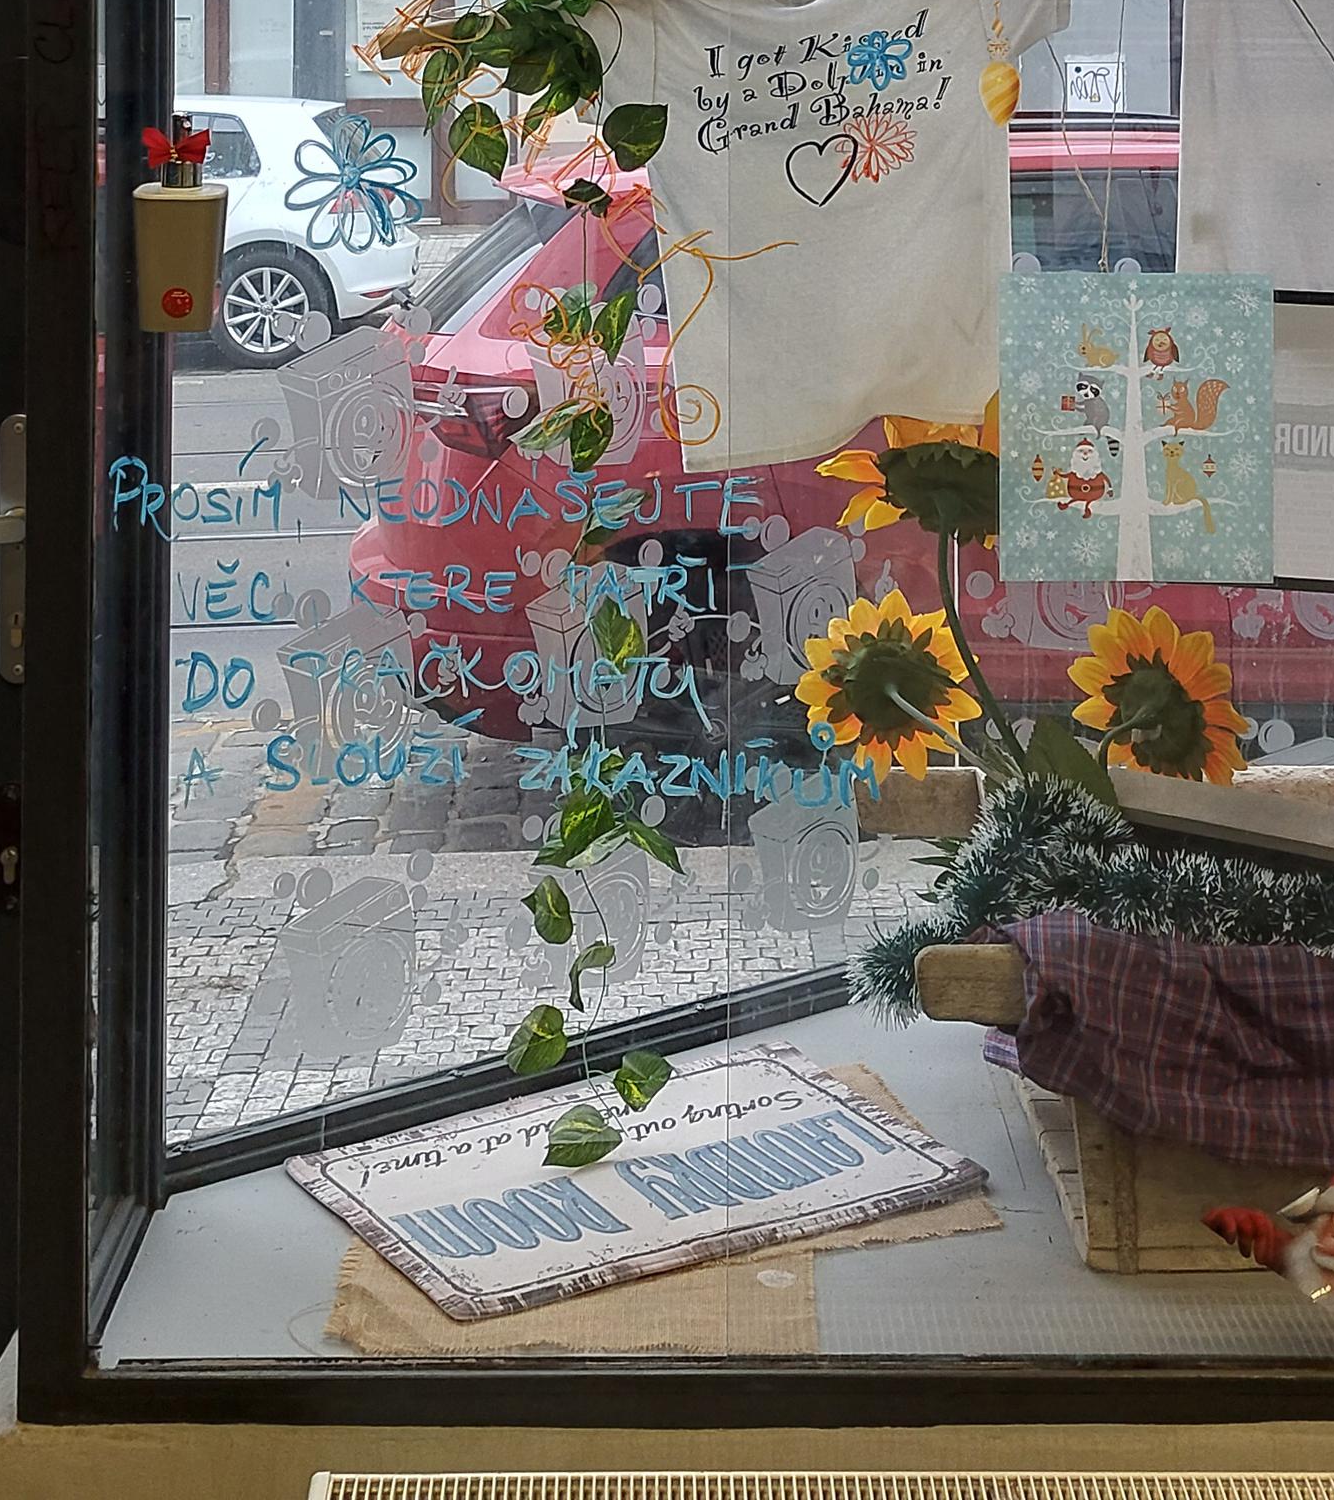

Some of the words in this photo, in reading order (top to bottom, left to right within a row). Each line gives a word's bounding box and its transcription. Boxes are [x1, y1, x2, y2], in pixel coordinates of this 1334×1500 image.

[693, 85, 730, 121] by
[743, 86, 758, 103] a
[915, 50, 945, 76] in
[704, 44, 726, 79] I
[736, 45, 787, 82] got
[697, 102, 800, 156] Grand
[809, 76, 954, 129] Bahama!
[337, 467, 765, 536] NEODNAŠEJTE
[176, 650, 255, 713] DO
[182, 747, 223, 800] A
[626, 1114, 678, 1142] out
[681, 1089, 805, 1127] Sorting
[453, 1141, 473, 1159] a
[477, 1126, 515, 1157] at
[614, 1109, 898, 1221] LAUNDRY
[358, 1150, 451, 1190] time!
[390, 1175, 633, 1260] ROOM
